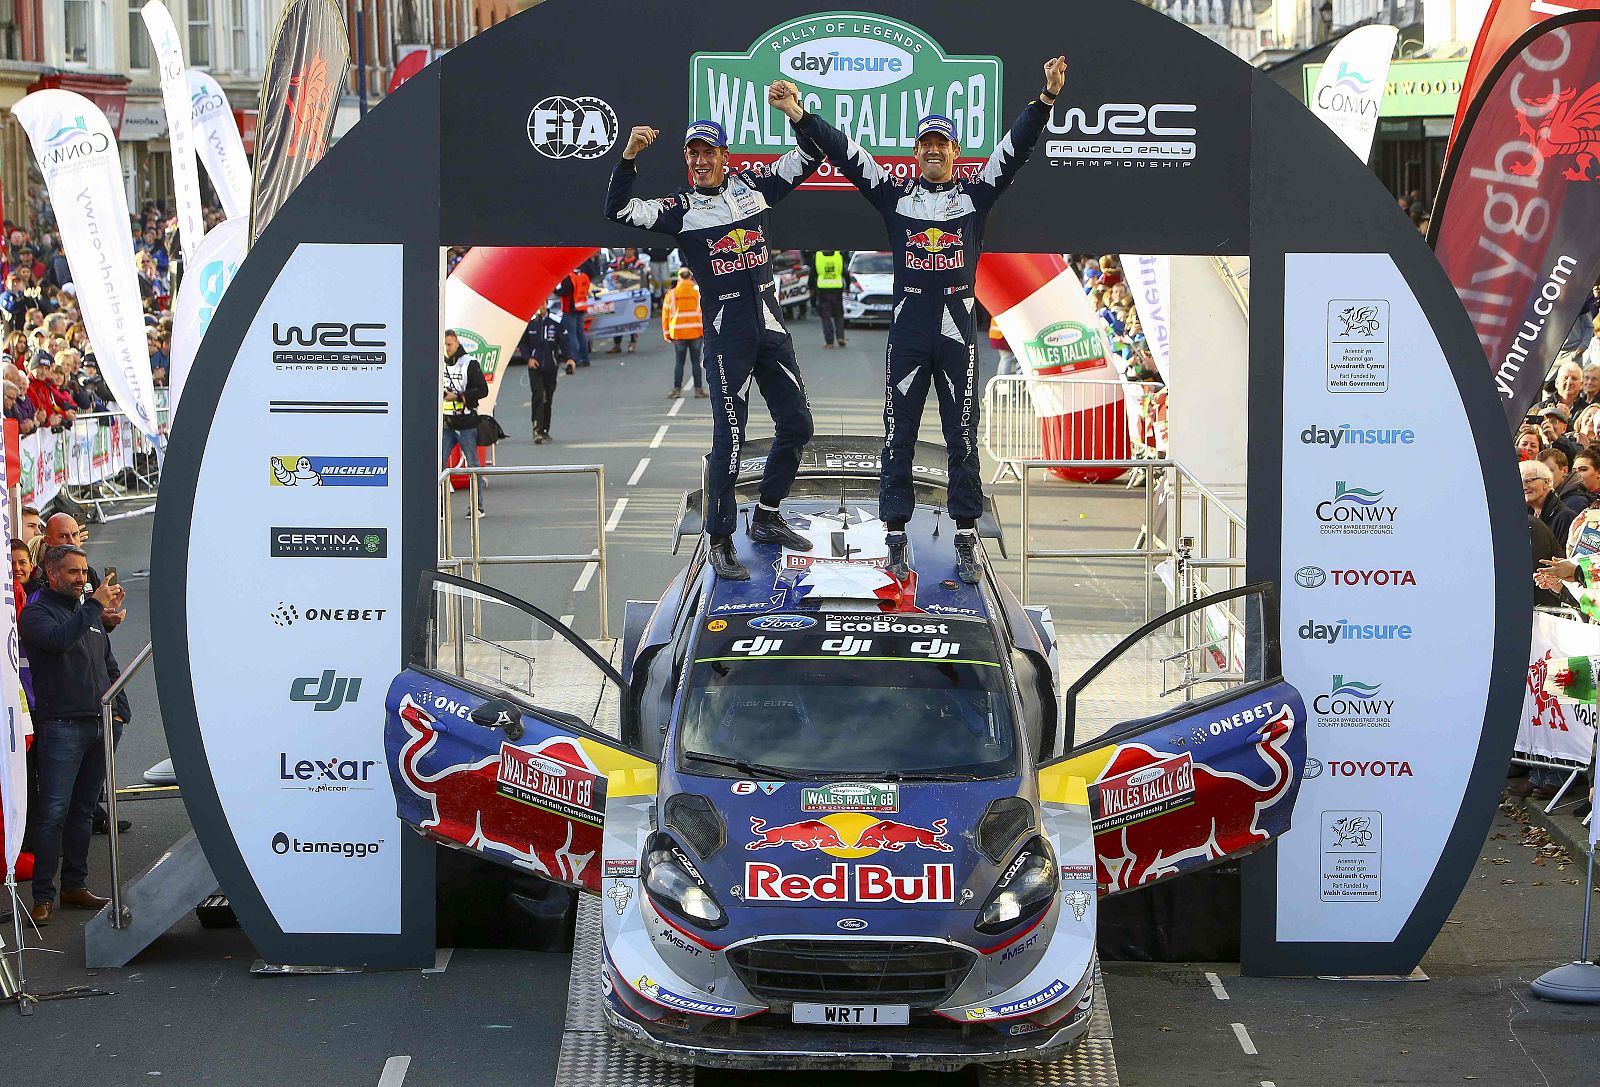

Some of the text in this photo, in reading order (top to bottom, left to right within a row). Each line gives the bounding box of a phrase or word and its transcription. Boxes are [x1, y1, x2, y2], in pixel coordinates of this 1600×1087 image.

[771, 23, 923, 53] RALLY OF LEGENDS
[790, 51, 903, 75] dayinsure
[946, 73, 986, 148] GB
[1046, 103, 1197, 136] WRC
[1137, 146, 1191, 154] RALLY
[1050, 160, 1191, 168] CHAMPIONSHIP
[712, 246, 769, 275] Red Bull
[906, 250, 964, 270] Red Bull
[272, 322, 386, 346] WRC
[484, 350, 497, 372] GB
[1026, 345, 1060, 365] WALES
[1062, 339, 1090, 362] RALLY
[717, 354, 727, 385] Powered
[965, 343, 975, 397] EcoBoost
[721, 385, 728, 394] by
[724, 396, 738, 425] FORD
[961, 398, 972, 427] FORD
[1300, 423, 1415, 449] dayinsure
[321, 466, 387, 475] MICHELIN
[1315, 501, 1398, 521] CONWY
[277, 534, 361, 545] CERTINA
[1331, 570, 1416, 586] TOYOTA
[305, 608, 387, 622] ONEBET
[761, 616, 804, 628] Ford
[883, 615, 899, 623] by
[825, 621, 949, 635] EcoBoost
[1298, 619, 1412, 644] dayinsure
[1313, 694, 1394, 715] CONWY
[1209, 702, 1275, 736] ONEBET
[280, 752, 375, 780] Lexar
[531, 760, 563, 775] dayinsure
[1130, 769, 1162, 784] dayinsure
[1328, 761, 1413, 777] TOYOTA
[503, 750, 592, 807] WALES RALLY GB
[736, 783, 752, 793] E
[1102, 761, 1190, 815] WALES RALLY GB
[521, 792, 603, 824] FIA World Rally Championship
[807, 791, 893, 806] WALES RALLY GB
[1093, 804, 1163, 830] World Rally Championship
[293, 838, 379, 857] tamaggo
[672, 847, 705, 885] LAZER
[998, 851, 1031, 888] LAZER
[746, 862, 953, 902] Red Bull
[844, 920, 861, 928] Ford
[660, 993, 734, 1014] MICHELIN
[1001, 982, 1064, 1013] MICHELIN
[825, 1006, 864, 1022] WRT
